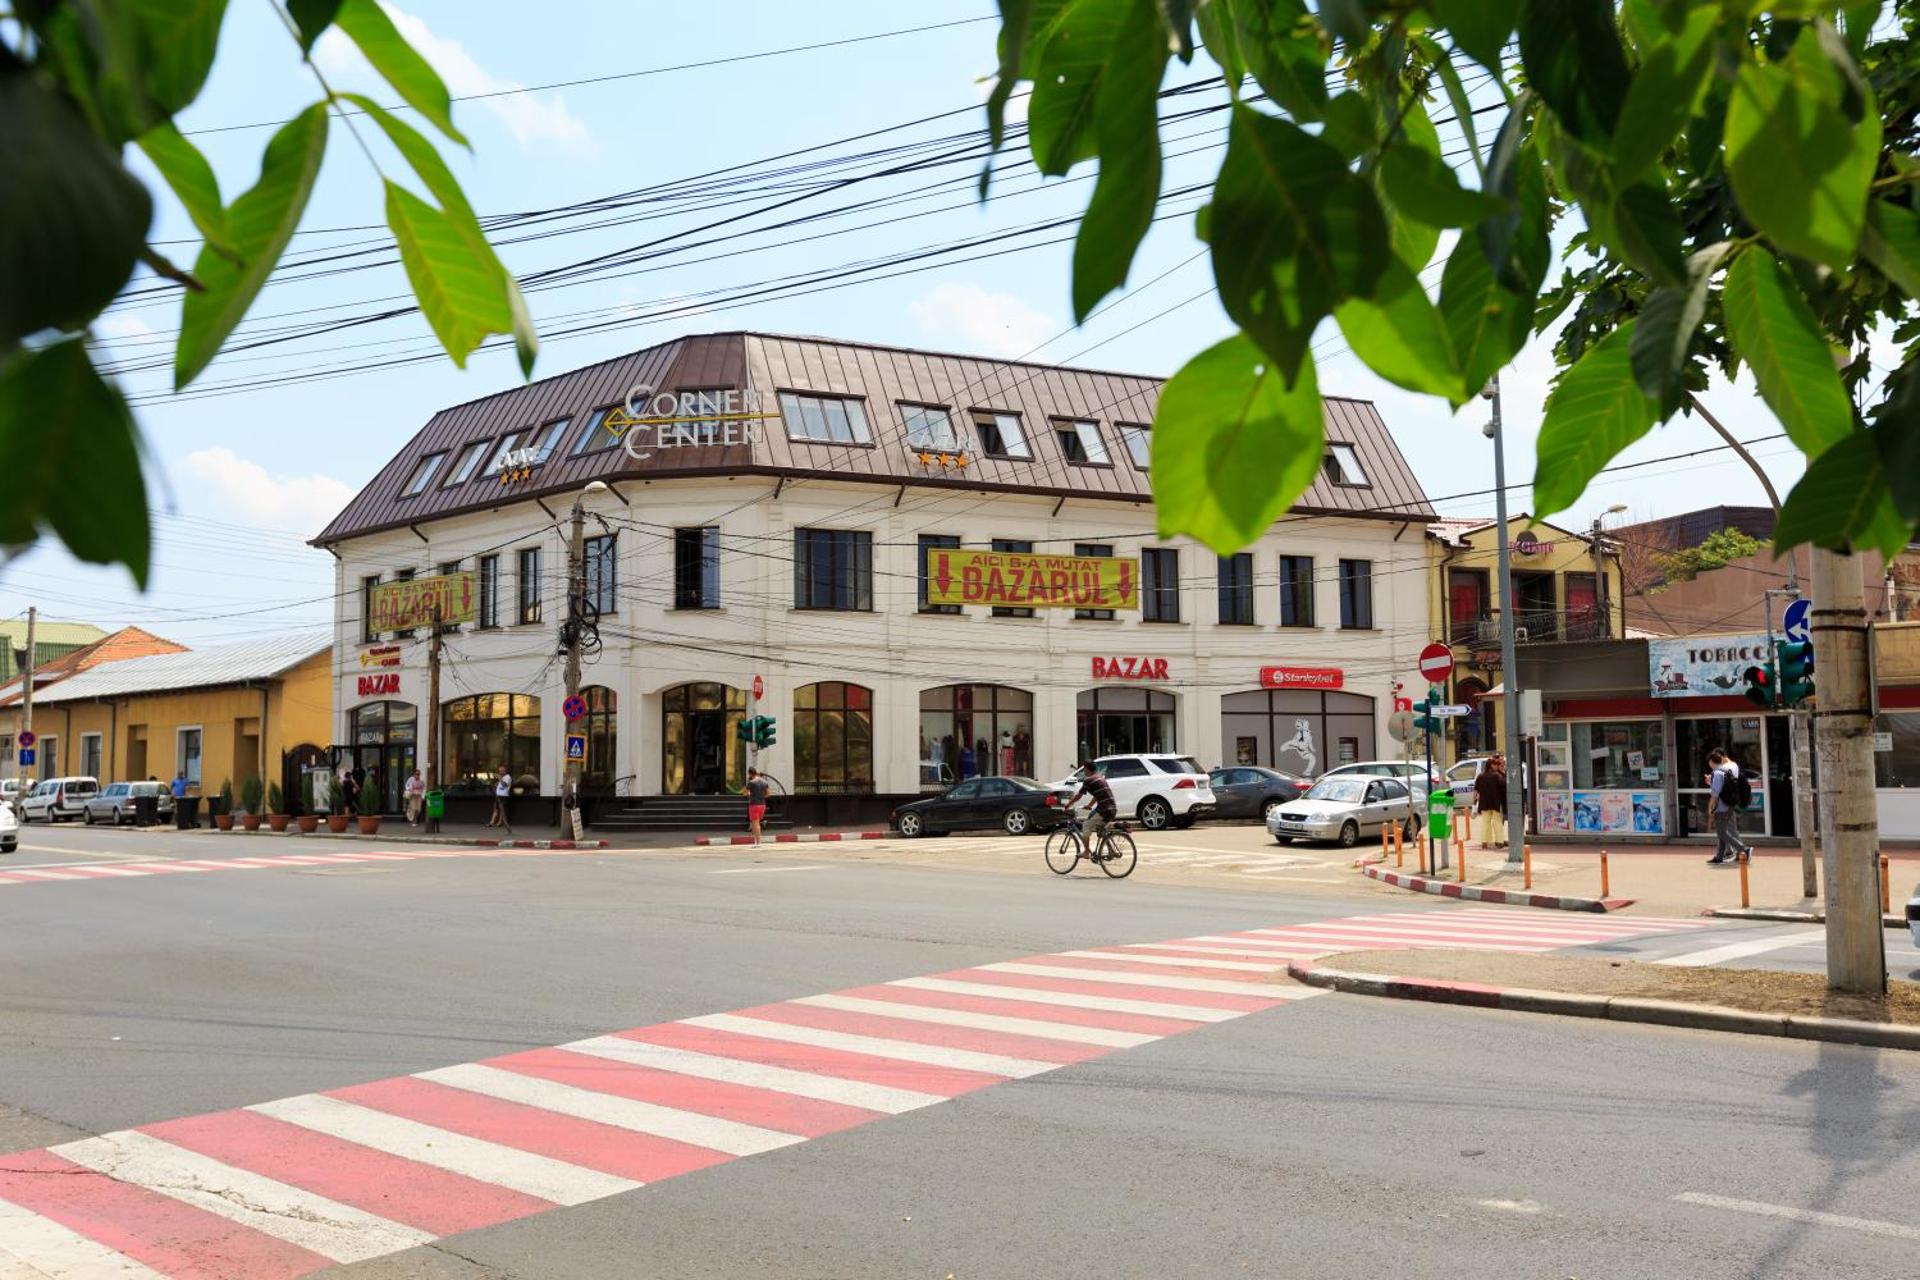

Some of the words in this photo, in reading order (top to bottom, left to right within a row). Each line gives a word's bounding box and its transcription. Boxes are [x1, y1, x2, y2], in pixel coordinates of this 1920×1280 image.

[625, 384, 759, 419] CORNER
[624, 425, 757, 459] CENTER
[970, 555, 1003, 567] AICI
[1046, 559, 1103, 572] MUTAT
[962, 565, 1108, 605] BAZARUL
[1092, 656, 1169, 680] BAZAR
[358, 673, 401, 697] BAZAR
